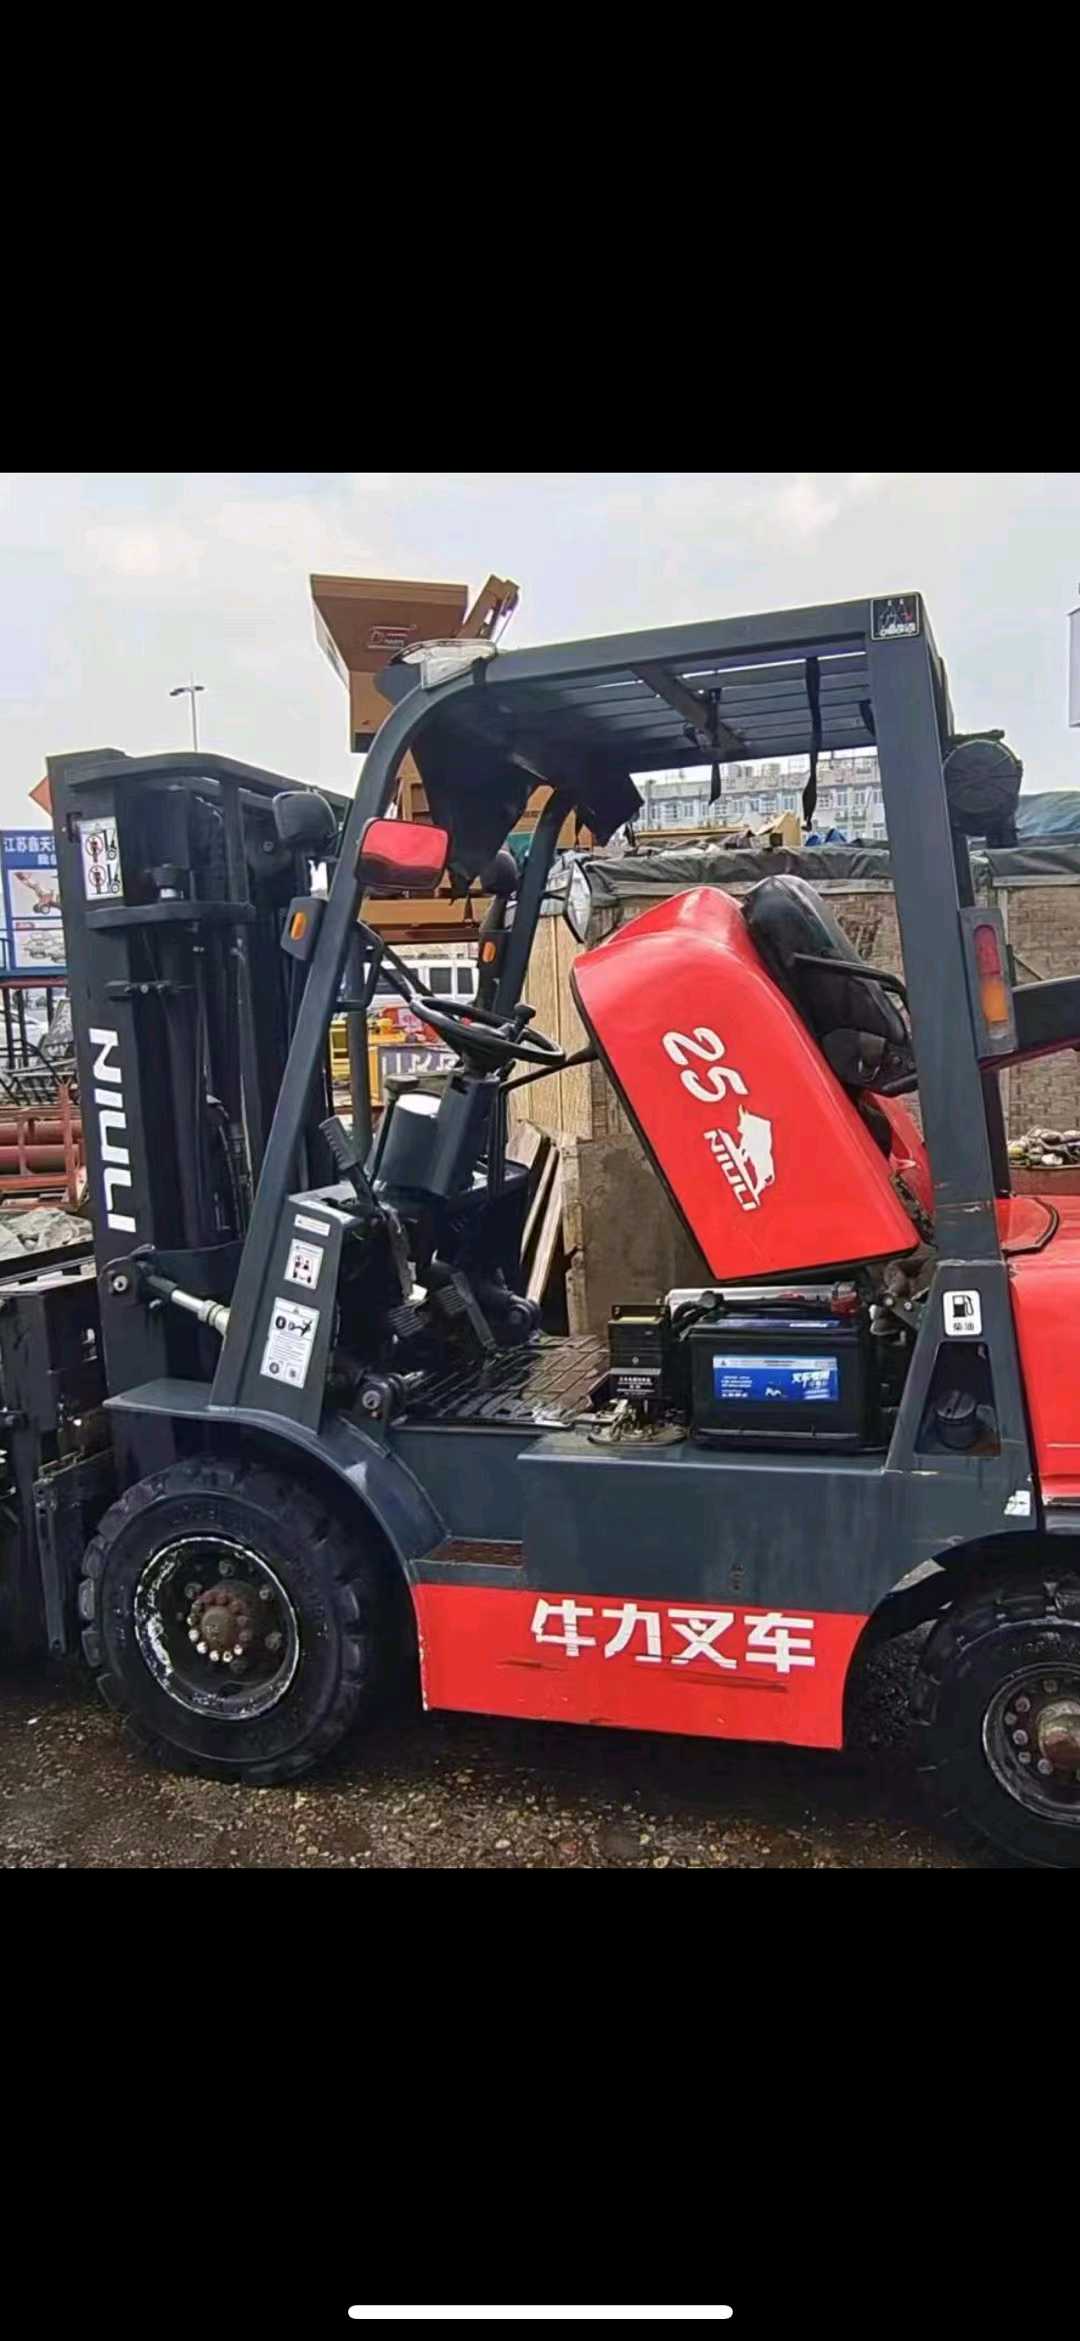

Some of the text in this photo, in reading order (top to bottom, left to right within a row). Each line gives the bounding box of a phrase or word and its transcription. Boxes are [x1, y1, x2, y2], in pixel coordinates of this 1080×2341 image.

[662, 1027, 749, 1102] 25
[89, 1028, 136, 1232] NIULI
[703, 1130, 758, 1211] NIULI
[531, 1598, 815, 1673] 牛力叉车
